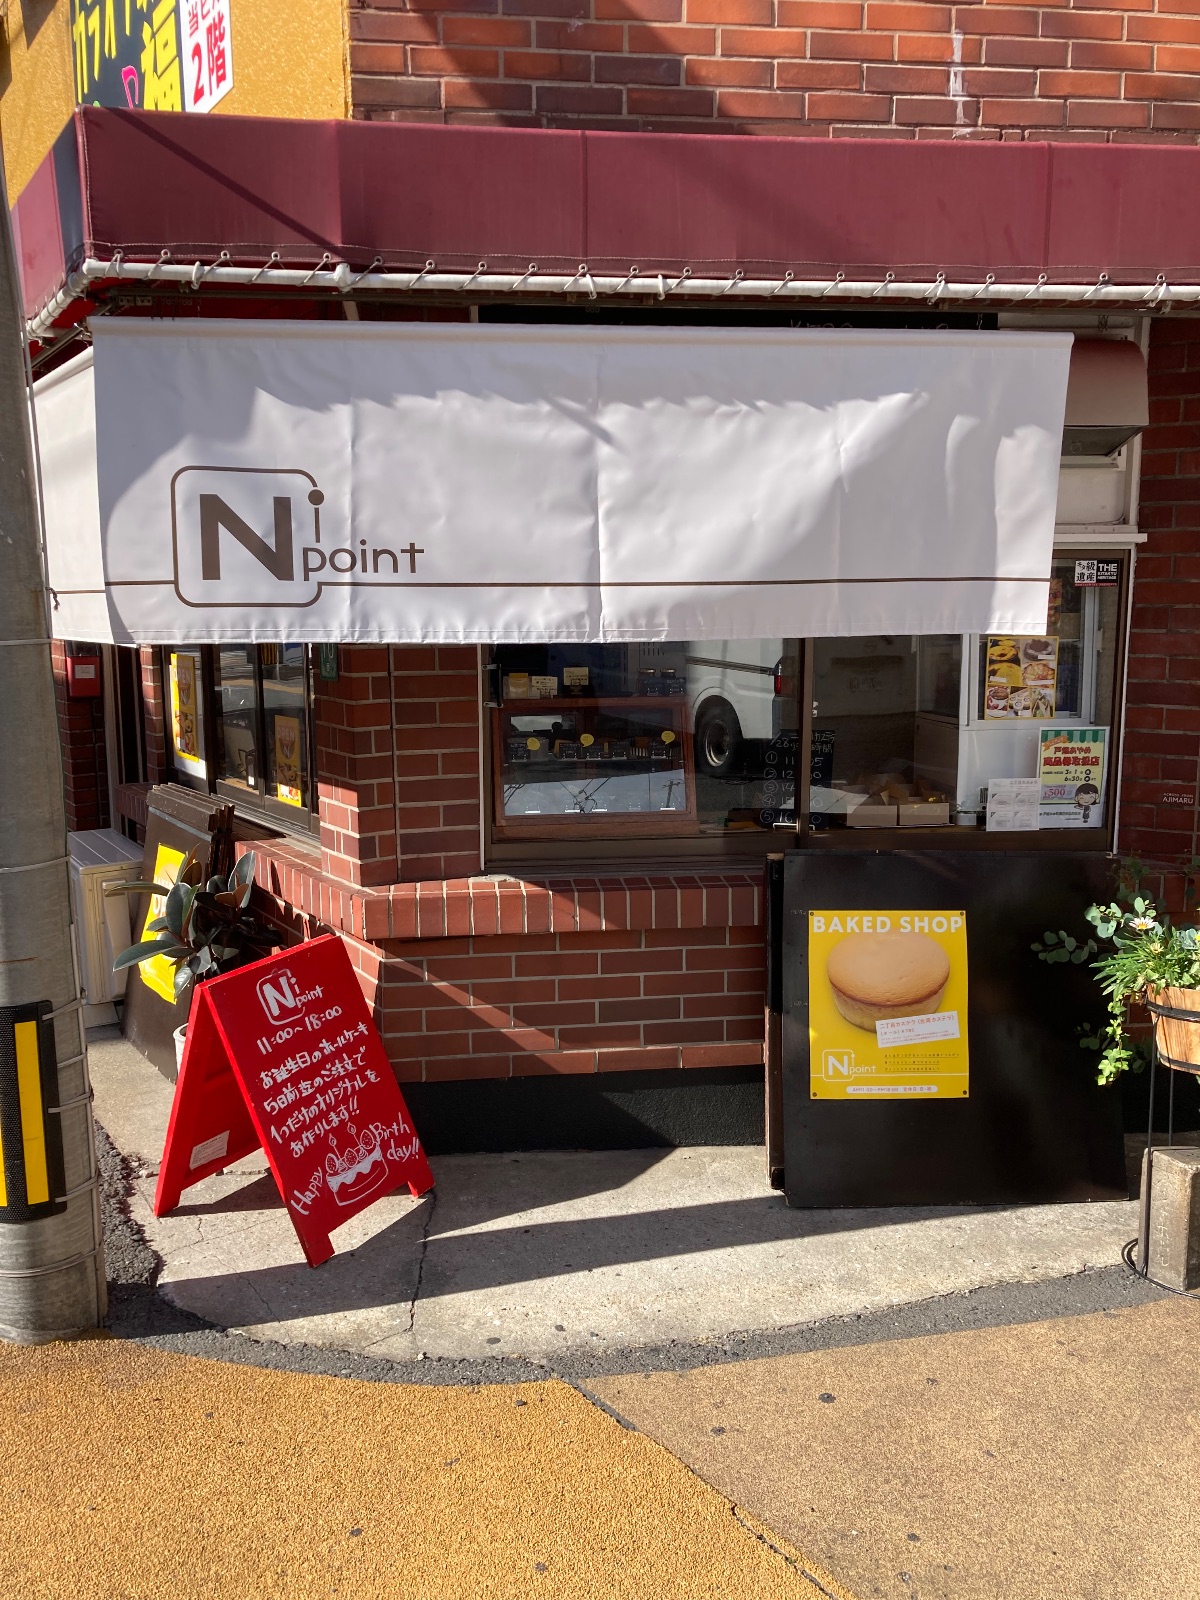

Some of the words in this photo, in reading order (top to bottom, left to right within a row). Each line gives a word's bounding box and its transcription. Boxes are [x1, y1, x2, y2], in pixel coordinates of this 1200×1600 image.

[191, 10, 227, 106] 2階
[302, 539, 425, 582] point
[1097, 563, 1118, 571] THE
[1162, 796, 1194, 804] AJIMARU
[812, 916, 892, 933] BAKED
[899, 916, 963, 933] SHOP
[295, 985, 324, 1009] point
[849, 1065, 877, 1076] point
[368, 1111, 411, 1141] Birth
[290, 1166, 323, 1216] Happy
